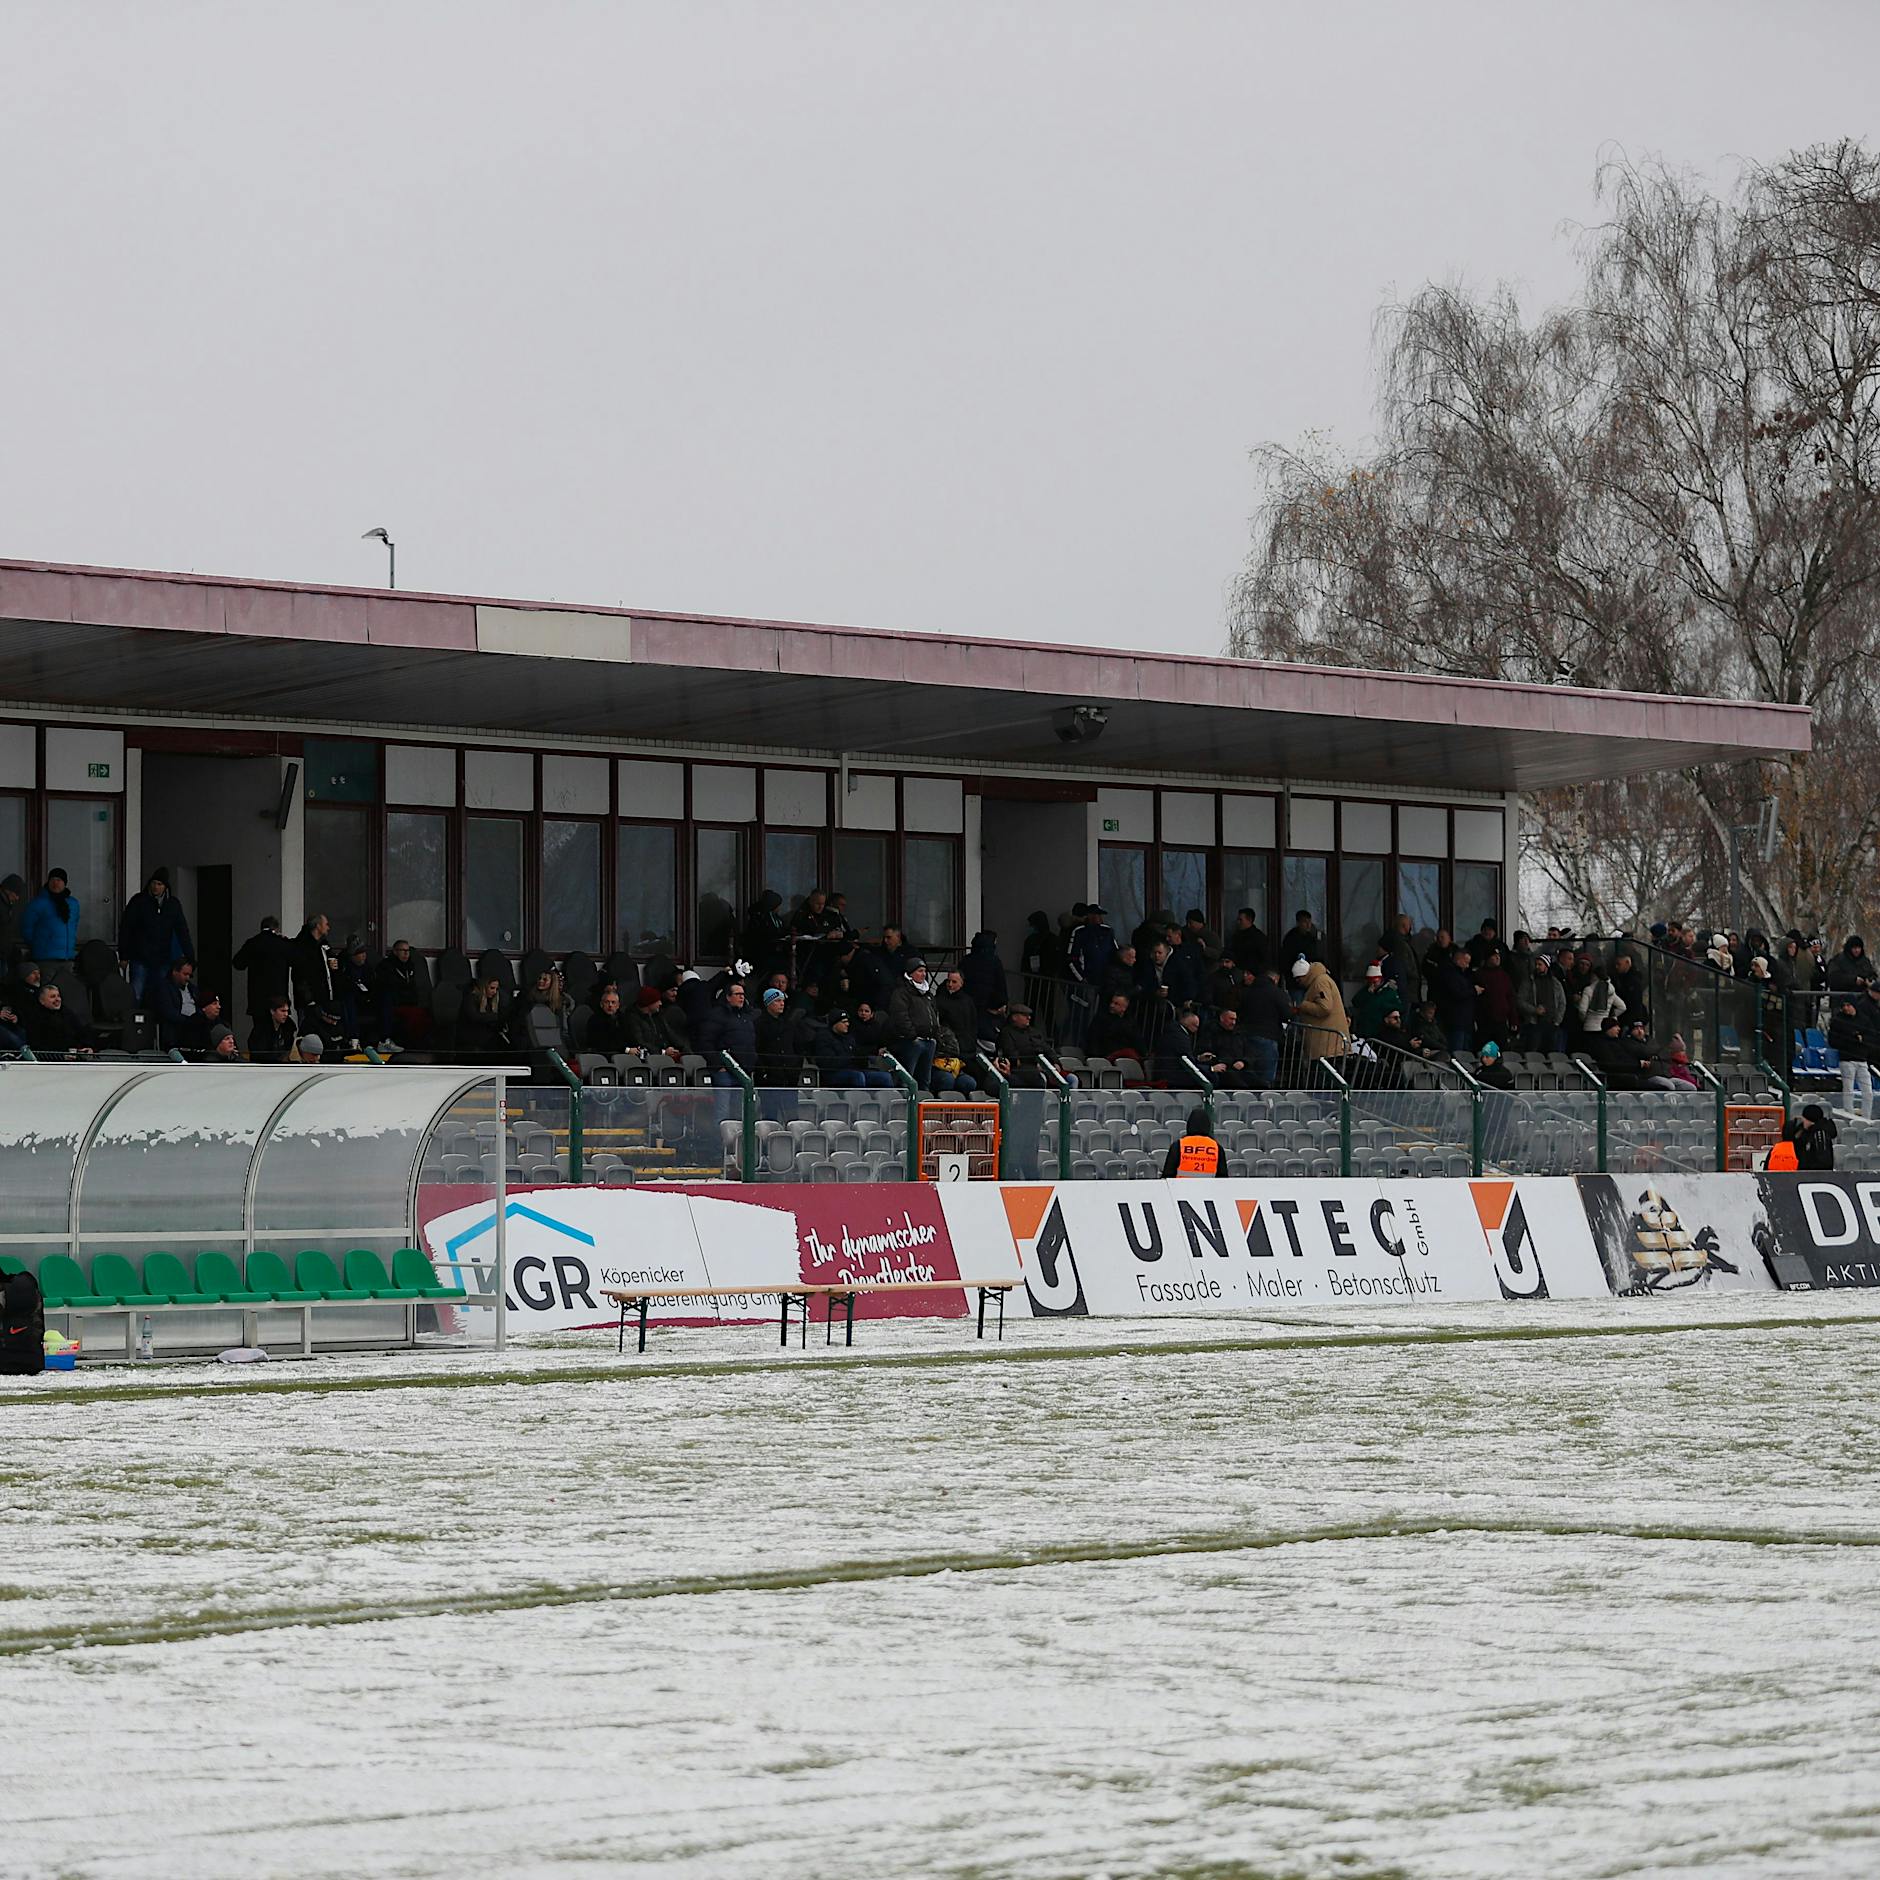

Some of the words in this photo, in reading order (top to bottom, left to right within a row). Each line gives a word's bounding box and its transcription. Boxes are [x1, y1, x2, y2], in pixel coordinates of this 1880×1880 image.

[1184, 1145, 1216, 1155] BFC
[949, 1164, 960, 1182] 2
[1194, 1162, 1205, 1171] 21
[1403, 1199, 1428, 1256] GmbH
[804, 1227, 836, 1267] Ihr
[842, 1210, 936, 1269] dynamischer
[600, 1266, 684, 1287] Köpenicker
[1136, 1269, 1222, 1302] Fassade
[1246, 1269, 1303, 1297] Maler
[1327, 1266, 1442, 1296] Betonschutz
